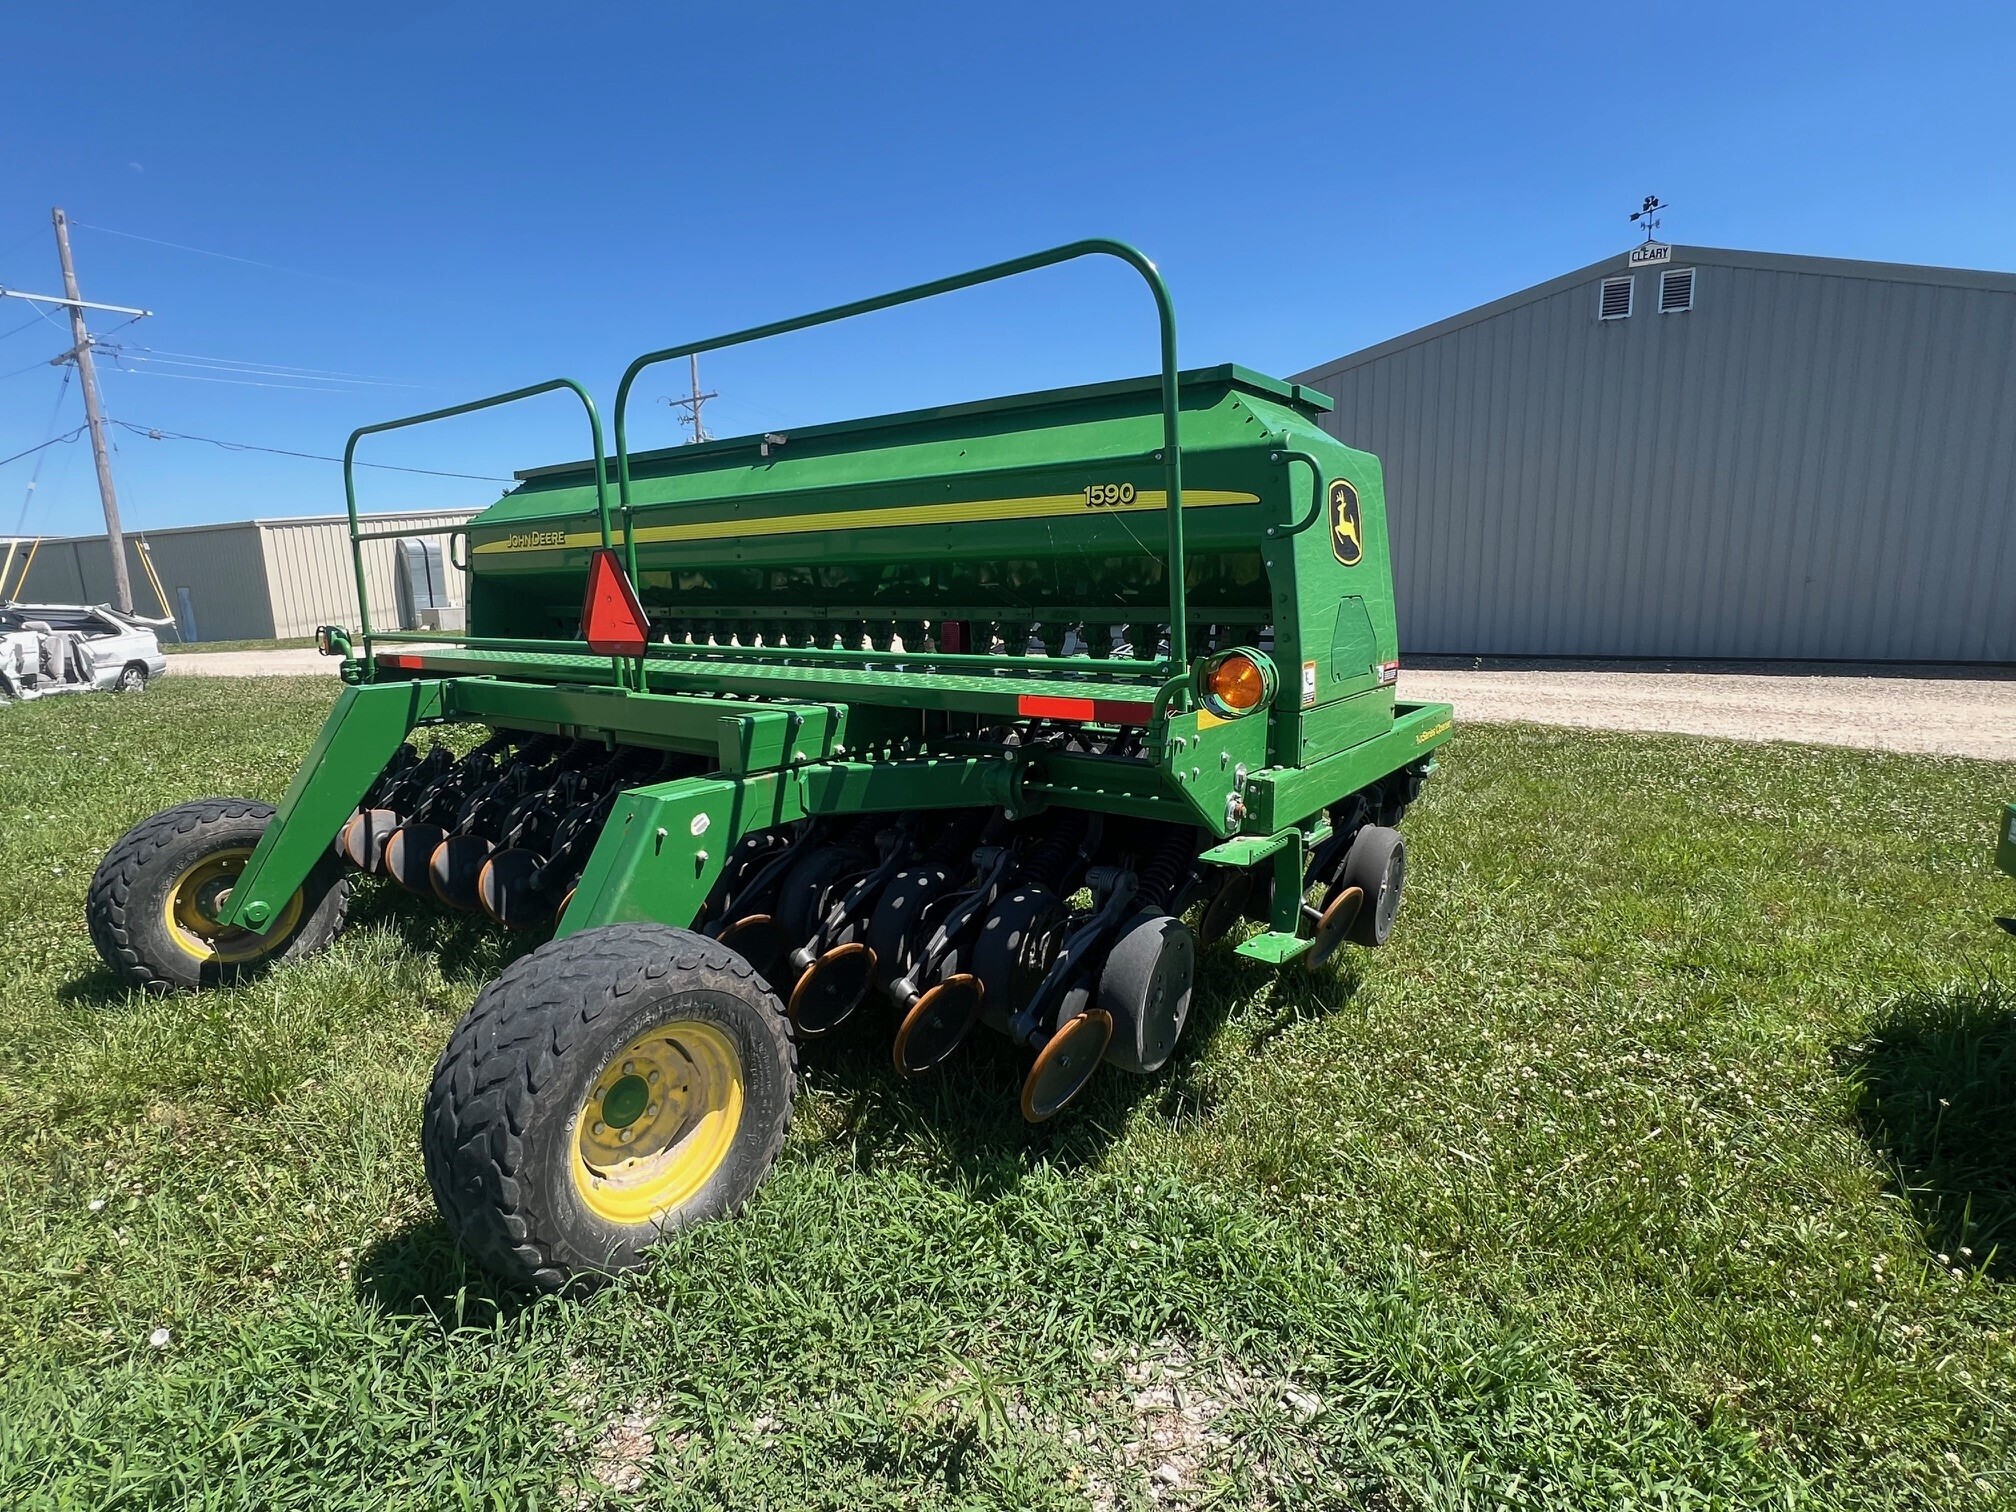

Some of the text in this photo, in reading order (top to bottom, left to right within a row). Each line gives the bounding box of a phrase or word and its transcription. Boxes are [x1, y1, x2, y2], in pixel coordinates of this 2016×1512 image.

[1632, 247, 1668, 261] CLEARY
[1083, 482, 1135, 506] 1590
[507, 530, 565, 548] JOHN DEERE
